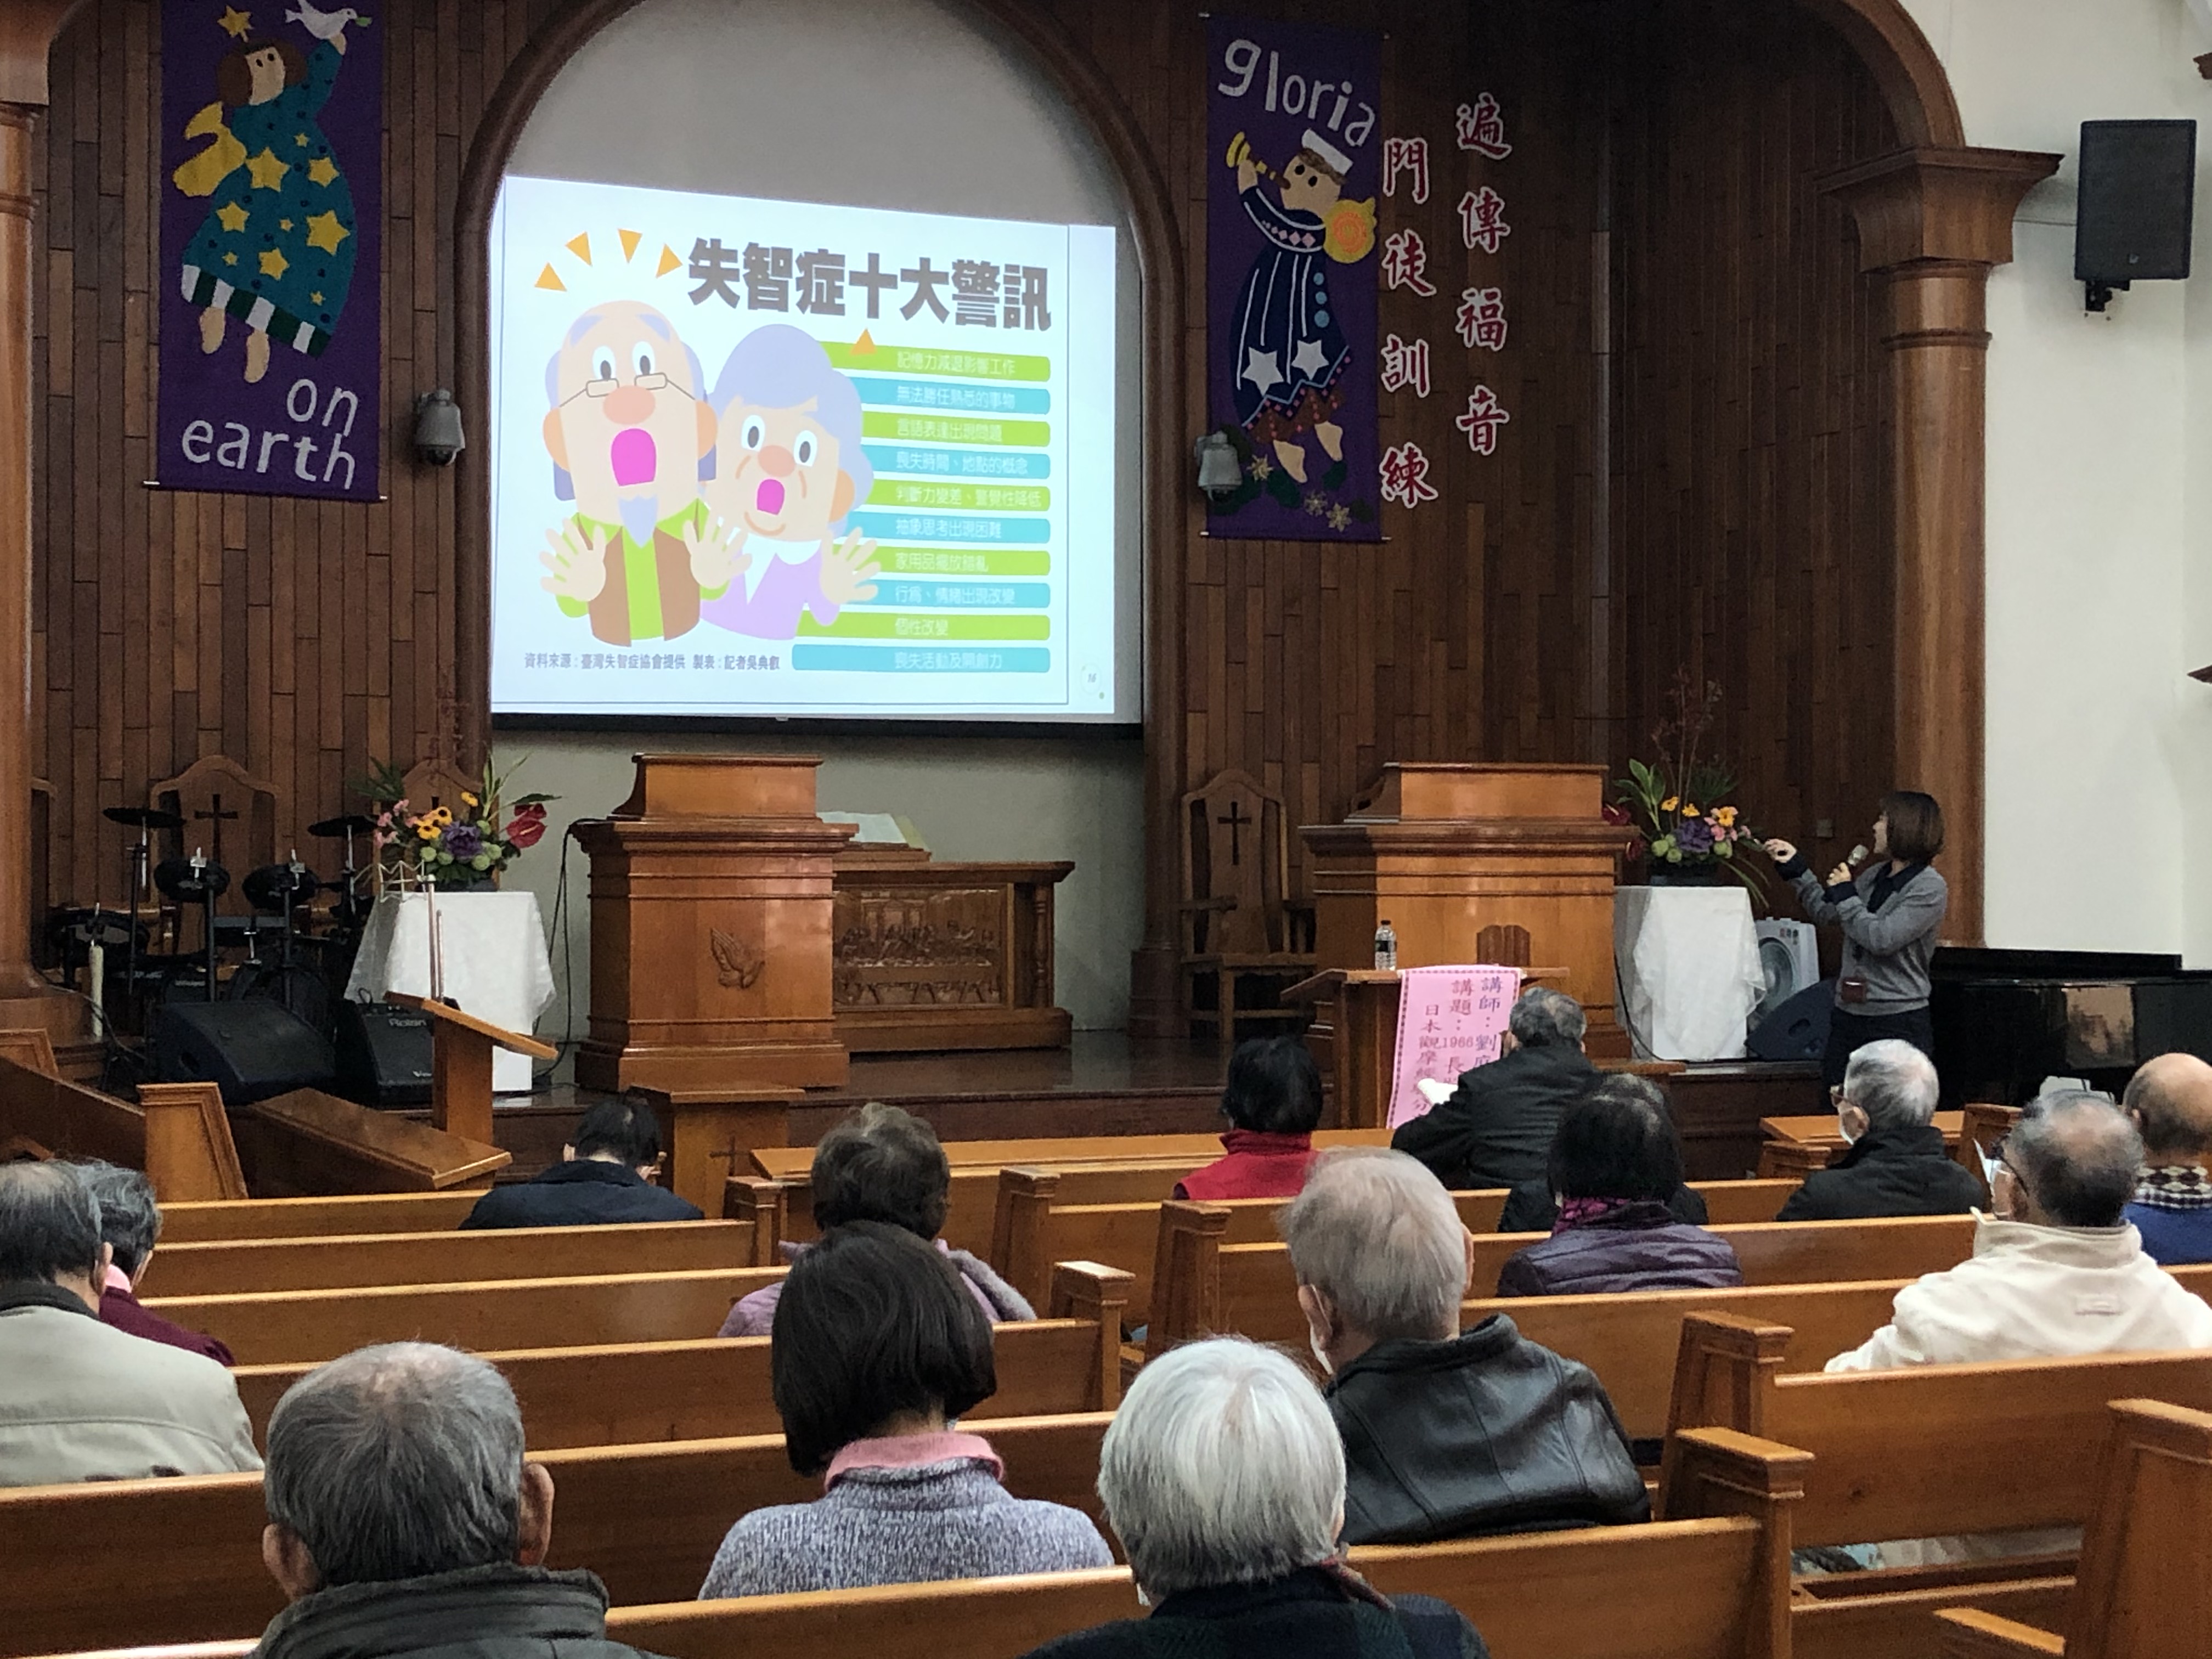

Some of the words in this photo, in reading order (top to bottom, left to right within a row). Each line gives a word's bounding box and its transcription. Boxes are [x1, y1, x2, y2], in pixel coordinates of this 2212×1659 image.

[1218, 38, 1375, 148] gloria
[688, 237, 1051, 331] 失智症十大警訊
[1456, 92, 1511, 455] 遍傳福音
[1379, 137, 1438, 509] 門徒訓練
[896, 351, 1016, 376] 記憶力減退影響工作
[286, 379, 358, 437] on
[896, 385, 1015, 409] 無法勝任熟悉的事物
[896, 418, 1002, 442] 言語表達出現問題
[182, 420, 356, 489] earth
[896, 518, 1002, 539] 抽象思考出現困難
[895, 618, 949, 636] 個性改變
[894, 652, 1002, 669] 喪失活動及開創力
